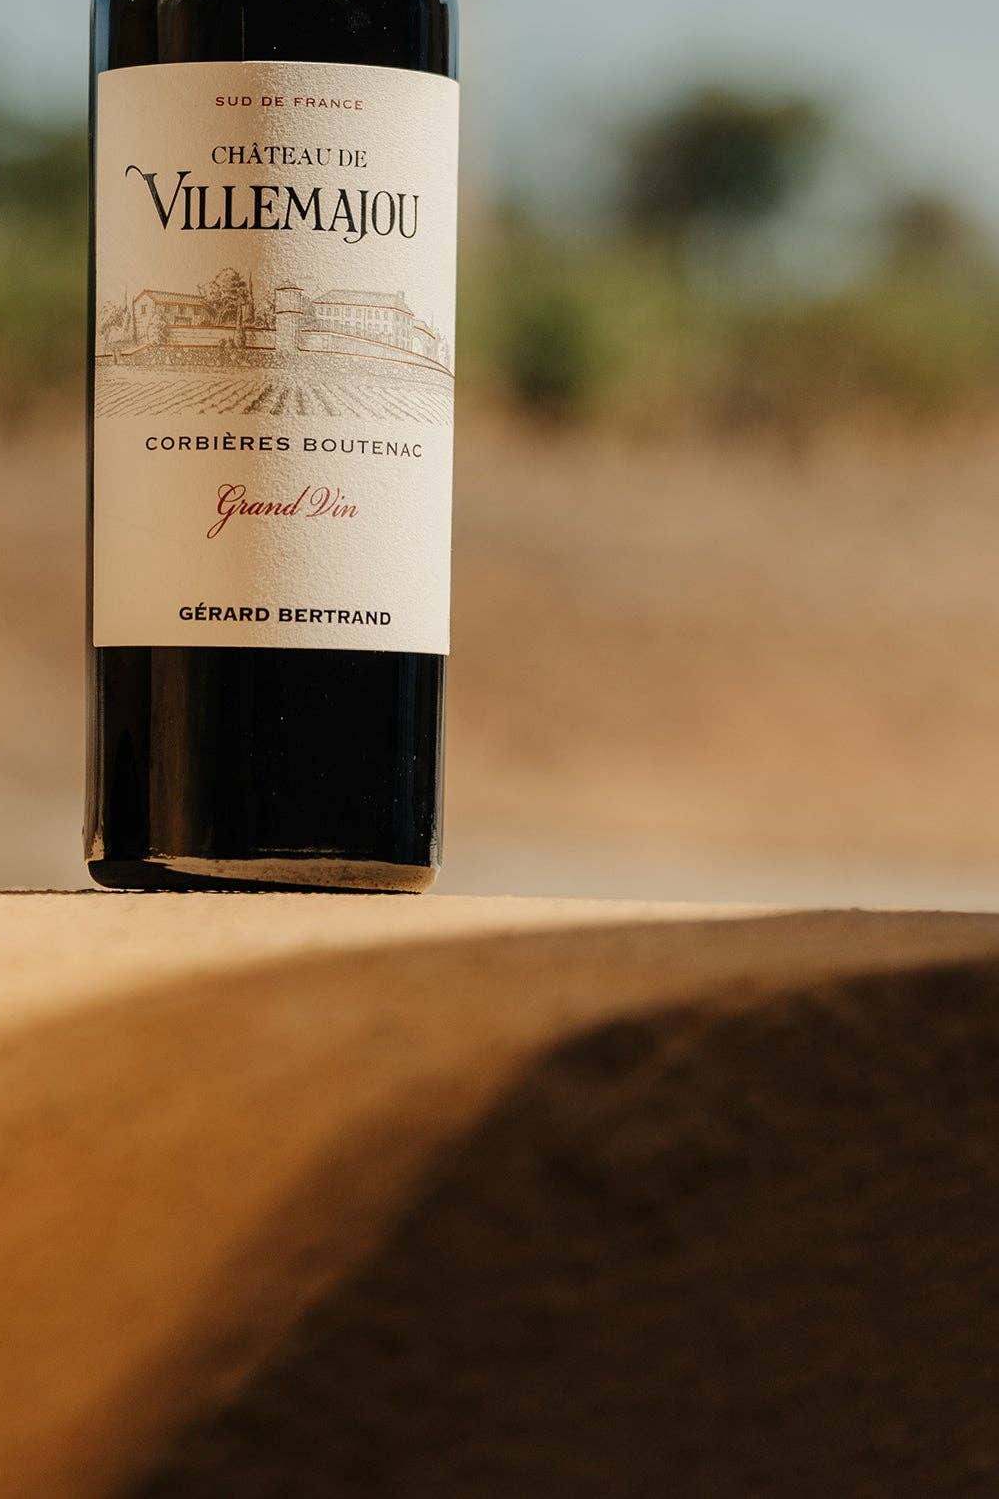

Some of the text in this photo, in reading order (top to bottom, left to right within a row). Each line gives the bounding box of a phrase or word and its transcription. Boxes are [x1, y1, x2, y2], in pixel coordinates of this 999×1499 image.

[215, 96, 364, 110] SUD DE FRANCE
[211, 142, 368, 168] CHÂTEAU DE
[125, 165, 419, 244] VILLEMAJOU
[145, 432, 423, 458] CORBIÈRES BOUTENAC
[206, 483, 359, 539] Grand Vin
[179, 602, 392, 626] GÉRARD BERTRAND
